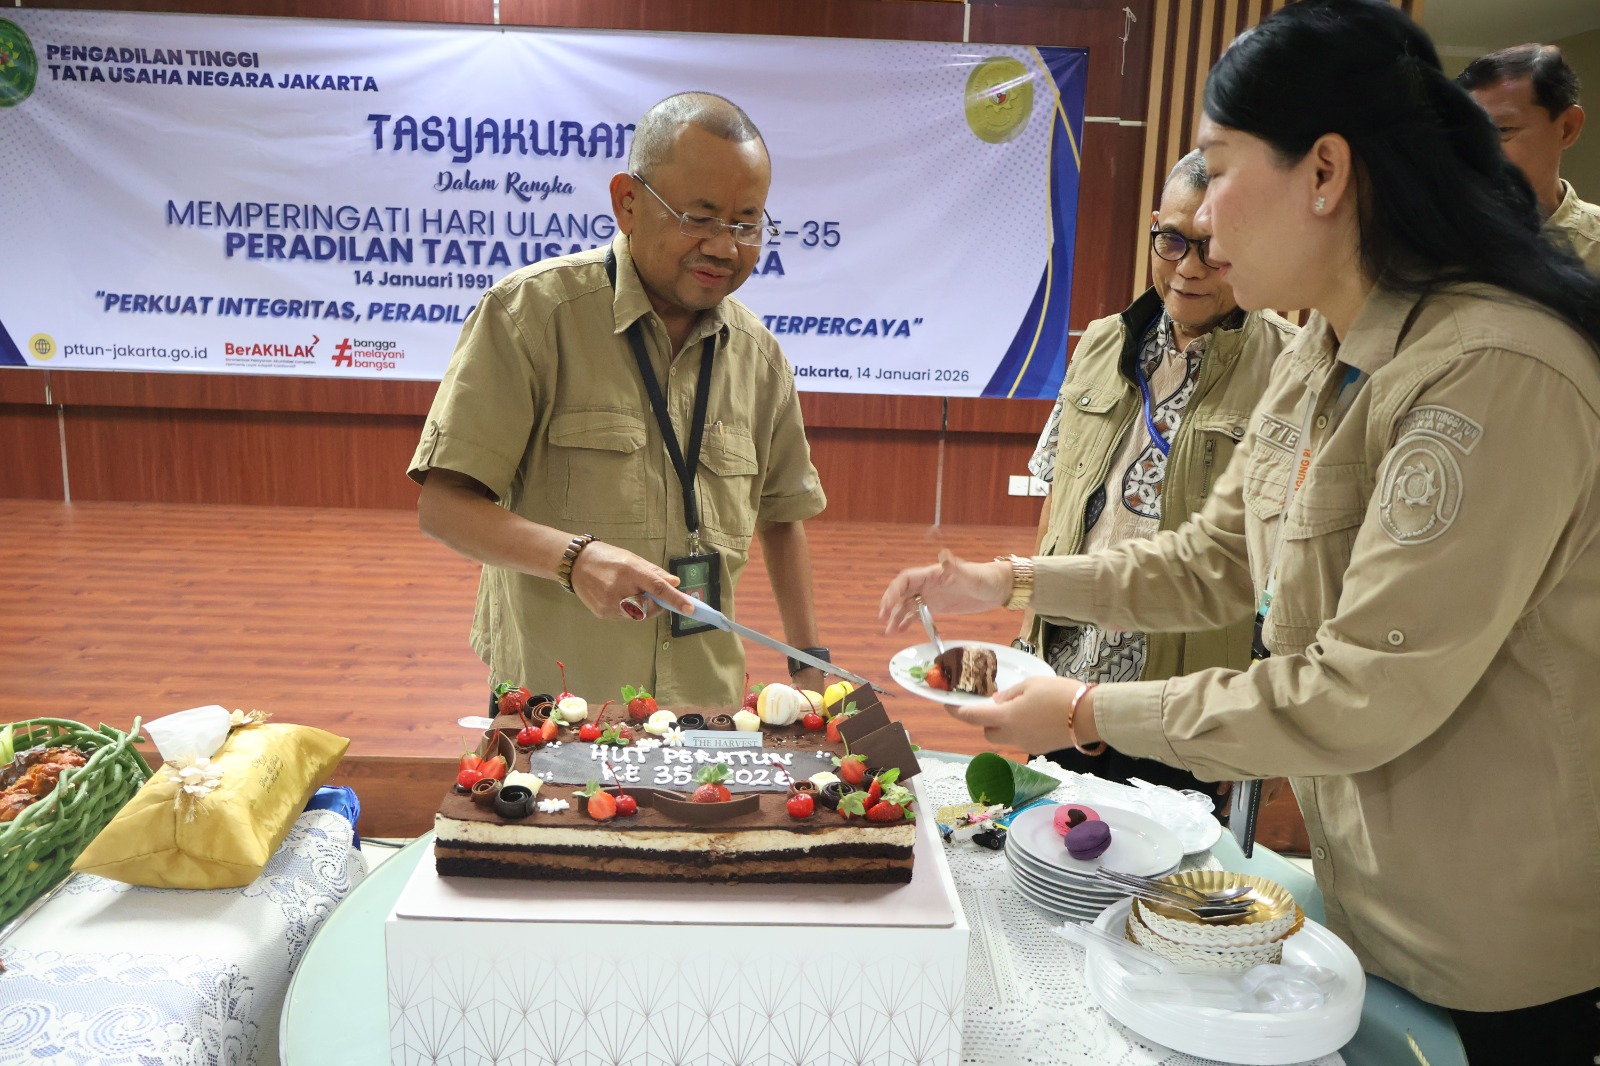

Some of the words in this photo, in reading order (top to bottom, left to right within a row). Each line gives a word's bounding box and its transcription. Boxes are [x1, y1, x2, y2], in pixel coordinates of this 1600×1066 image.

[47, 44, 183, 66] PENGADILAN
[186, 50, 259, 68] TINGGI
[51, 64, 105, 82] TATA
[108, 67, 183, 85] USAHA
[187, 71, 274, 88] NEGARA
[278, 74, 379, 92] JAKARTA
[434, 169, 499, 192] Dalam
[505, 171, 576, 201] Rangka
[167, 200, 410, 233] MEMPERINGATI
[423, 208, 495, 236] HARI
[507, 211, 615, 239] ULANG
[226, 232, 412, 263] PERADILAN
[422, 238, 511, 266] TATA
[354, 270, 373, 286] 14
[378, 271, 453, 288] Januari
[457, 273, 493, 288] 1991
[218, 297, 362, 323] INTEGRITAS,
[367, 302, 476, 322] PERADIL
[64, 344, 208, 361] pttun-jakarta.go.id
[225, 343, 315, 358] BerAKHLAK
[353, 338, 396, 350] bangga
[354, 350, 405, 360] melayani
[354, 359, 396, 371] bangsa
[794, 365, 853, 380] Jakarta,
[856, 367, 871, 379] 14
[875, 367, 931, 381] Januari
[935, 369, 970, 382] 2026
[692, 738, 713, 748] THE
[716, 739, 759, 749] HARVEST
[589, 743, 651, 764] HUT
[653, 764, 694, 787] 35
